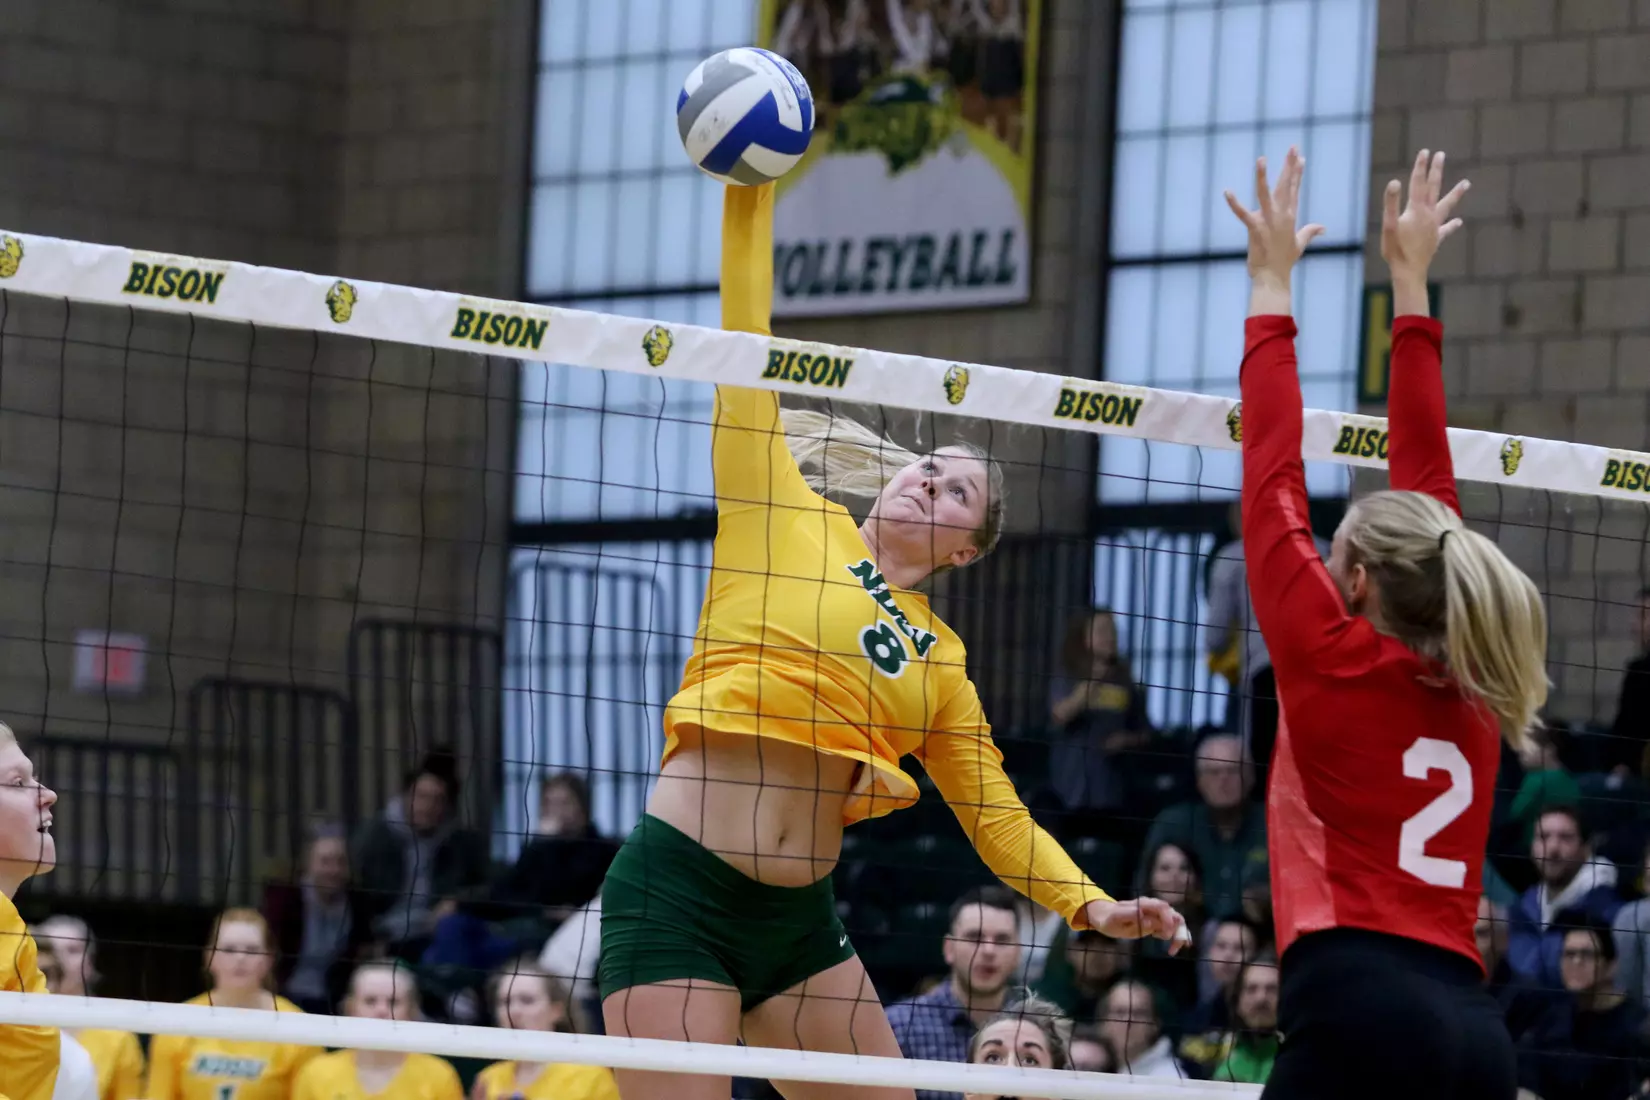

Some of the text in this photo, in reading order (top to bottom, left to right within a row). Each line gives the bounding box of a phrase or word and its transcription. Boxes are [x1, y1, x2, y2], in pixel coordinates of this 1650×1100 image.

[122, 261, 225, 304] BISON
[449, 307, 549, 350] BISON
[760, 348, 854, 389] BISON
[1054, 387, 1143, 428] BISON
[858, 619, 910, 679] 8
[1398, 736, 1474, 889] 2
